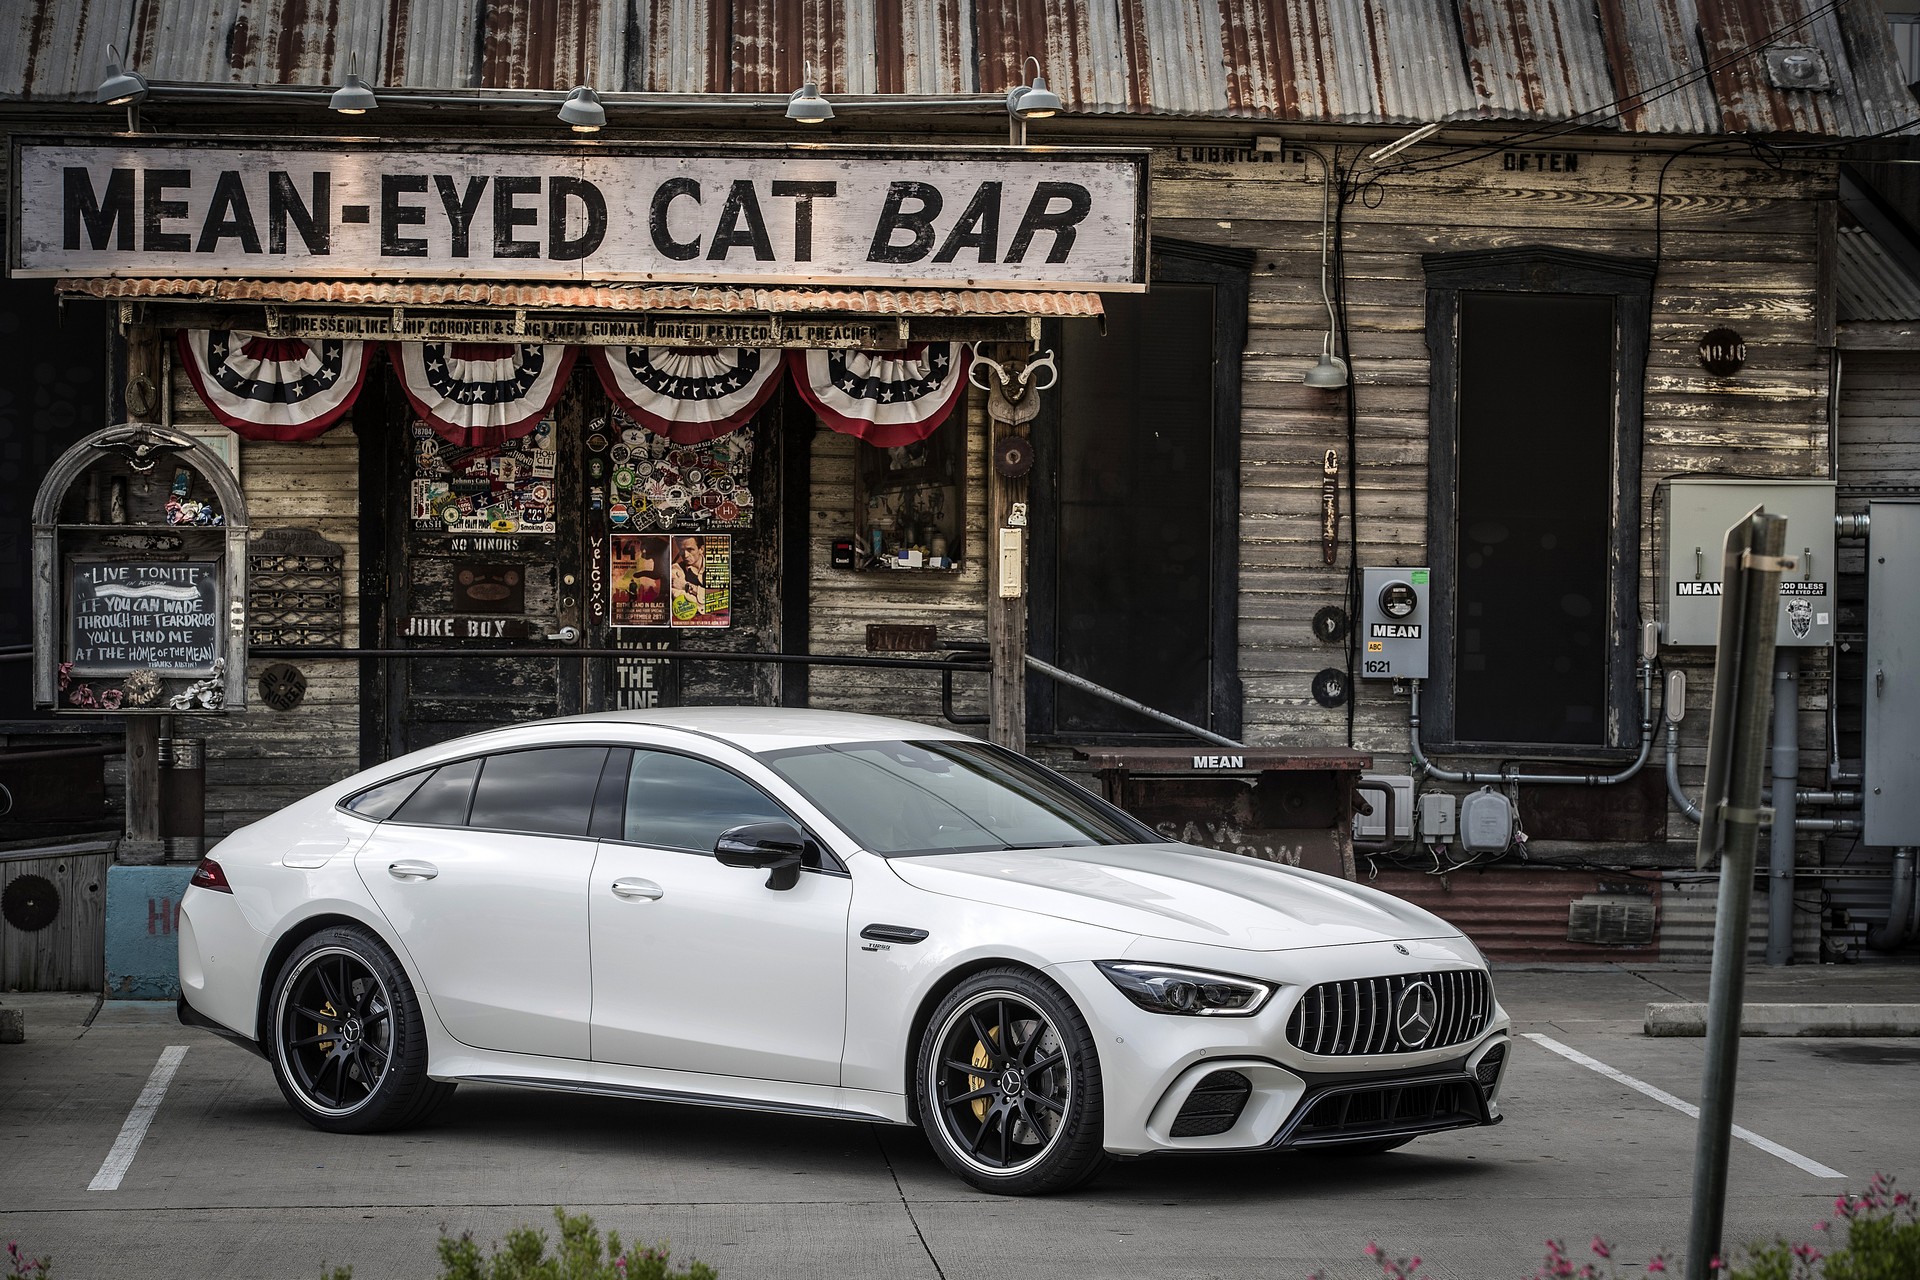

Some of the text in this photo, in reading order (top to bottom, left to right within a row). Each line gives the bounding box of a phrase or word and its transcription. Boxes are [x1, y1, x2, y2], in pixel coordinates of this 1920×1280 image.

[1504, 153, 1578, 172] OFTEN
[62, 166, 1092, 264] MEAN-EYED CAT BAR
[293, 316, 354, 333] DRESSED
[357, 318, 388, 333] LIKE
[430, 320, 490, 335] CORONER
[494, 321, 504, 334] &
[506, 321, 541, 336] SNG
[592, 322, 644, 337] GUNMAN
[807, 326, 877, 340] PREACHER
[415, 520, 442, 528] CASH
[521, 524, 543, 532] Smoking
[451, 538, 520, 550] NO MINORS
[92, 567, 200, 585] LIVE TONITE
[1679, 582, 1723, 595] MEAN
[104, 597, 131, 612] YOU
[133, 598, 160, 612] CAN
[164, 599, 204, 614] WADE
[76, 612, 216, 629] THROUGH THE TEARDROPS
[405, 617, 506, 638] JUKE BOX
[87, 629, 193, 646] YOU'LL FIND ME
[1373, 624, 1420, 638] MEAN
[75, 647, 94, 661] AT
[98, 647, 126, 661] THE
[129, 646, 158, 662] HOME
[158, 648, 168, 657] OF
[170, 647, 185, 658] THE
[1369, 643, 1381, 651] ABC
[1364, 660, 1391, 673] 1621
[283, 669, 296, 683] ID
[617, 666, 653, 689] THE
[617, 690, 658, 711] LINE
[1194, 756, 1244, 768] MEAN
[1156, 821, 1243, 844] SAW
